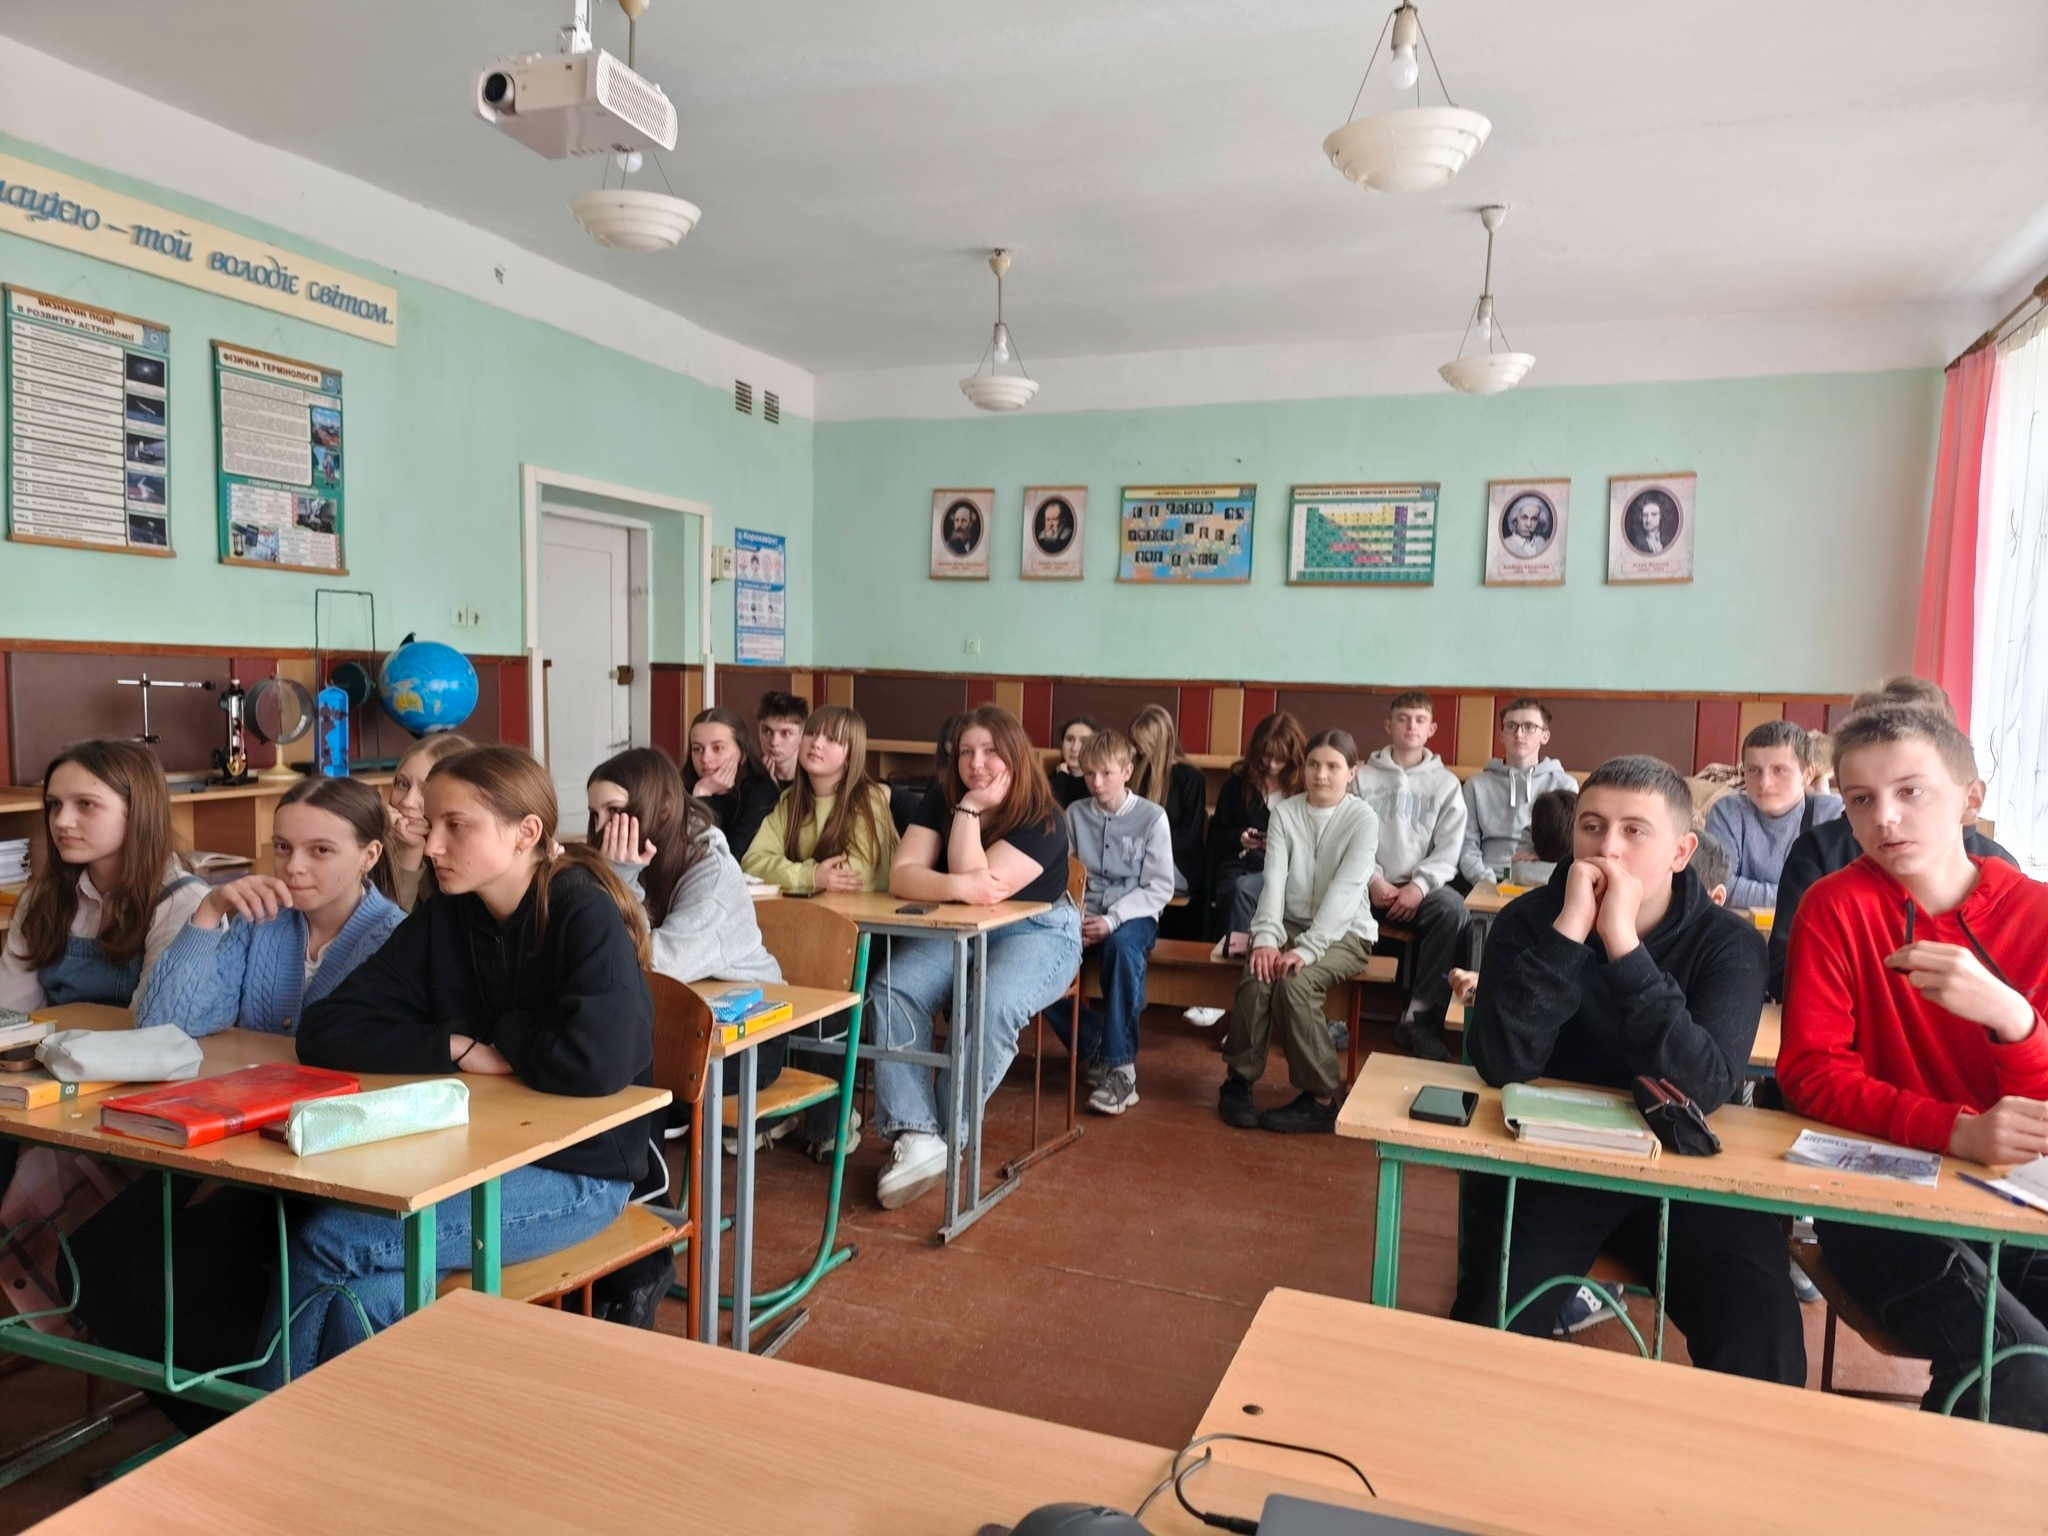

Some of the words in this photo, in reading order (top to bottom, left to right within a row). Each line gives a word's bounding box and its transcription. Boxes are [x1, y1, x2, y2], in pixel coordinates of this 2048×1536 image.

[0, 181, 99, 231] ацією
[129, 225, 193, 262] той
[207, 251, 299, 295] володіє
[17, 304, 24, 313] В
[26, 307, 76, 326] РОЗВИТКУ
[78, 321, 135, 341] АСТРОНОМІЇ
[223, 352, 260, 369] ФІЗИЧНА
[262, 362, 319, 383] ТЕРМІНОЛОГІЯ
[248, 478, 282, 490] ГОВОРИМО
[65, 1084, 75, 1094] 8
